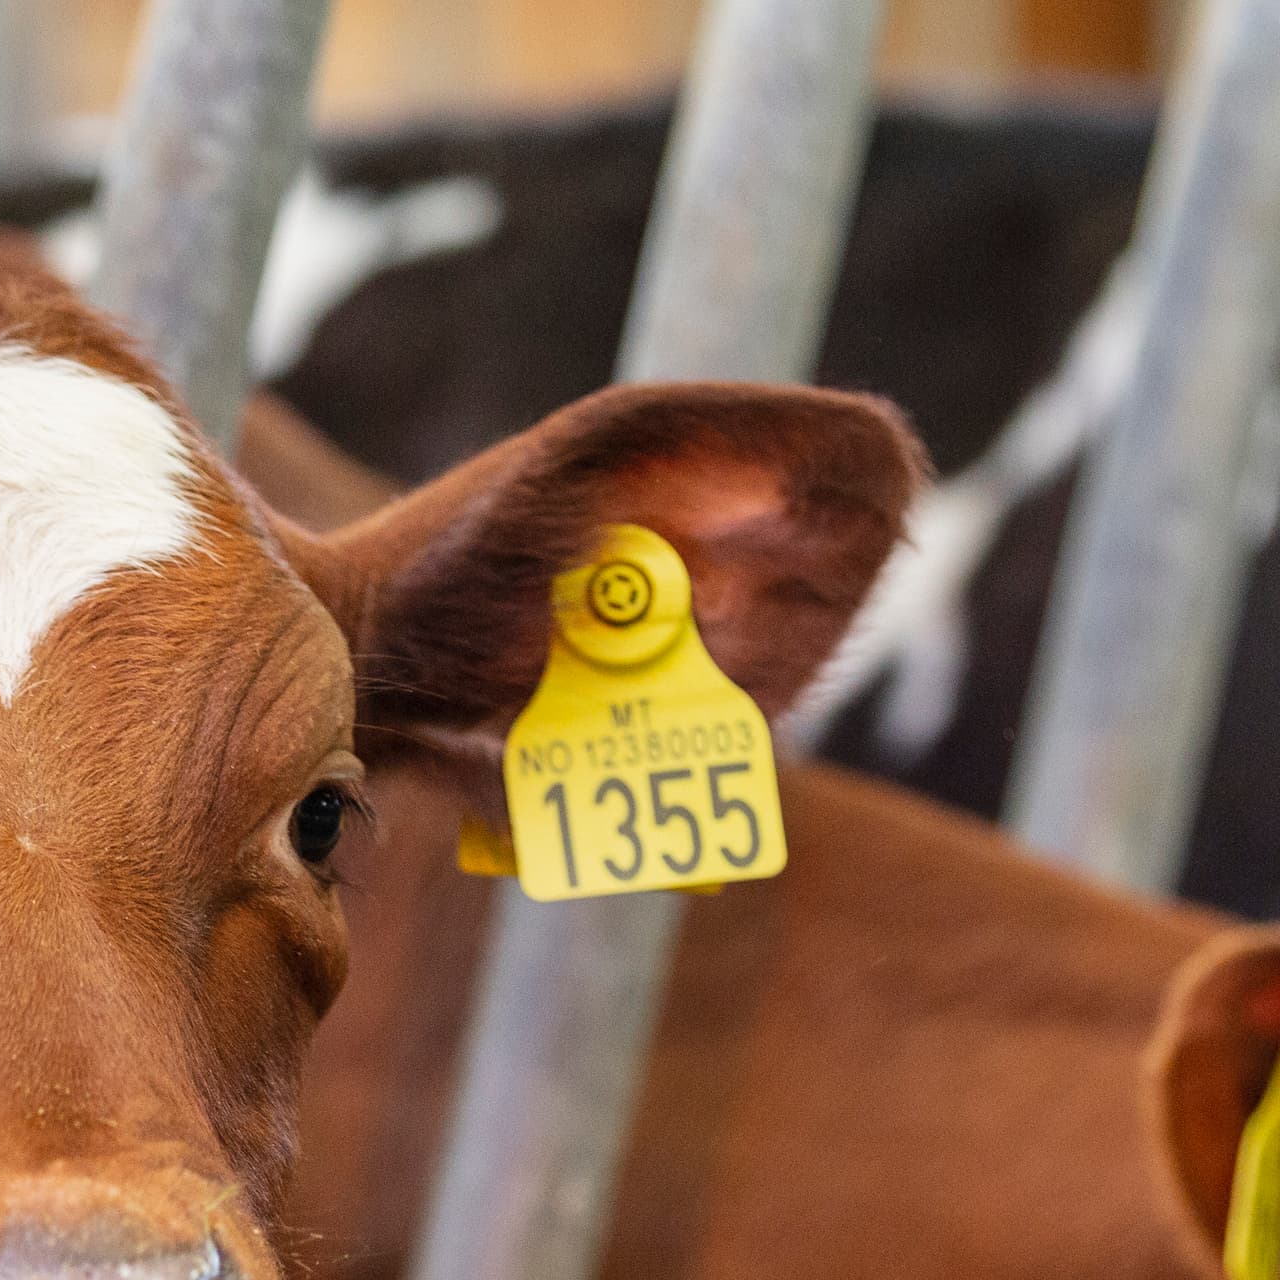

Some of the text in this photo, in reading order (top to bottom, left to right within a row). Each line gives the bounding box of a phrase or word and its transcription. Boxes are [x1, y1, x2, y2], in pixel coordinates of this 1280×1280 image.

[609, 698, 651, 728] MT
[519, 720, 754, 777] NO 12380003
[543, 762, 760, 888] 1355
